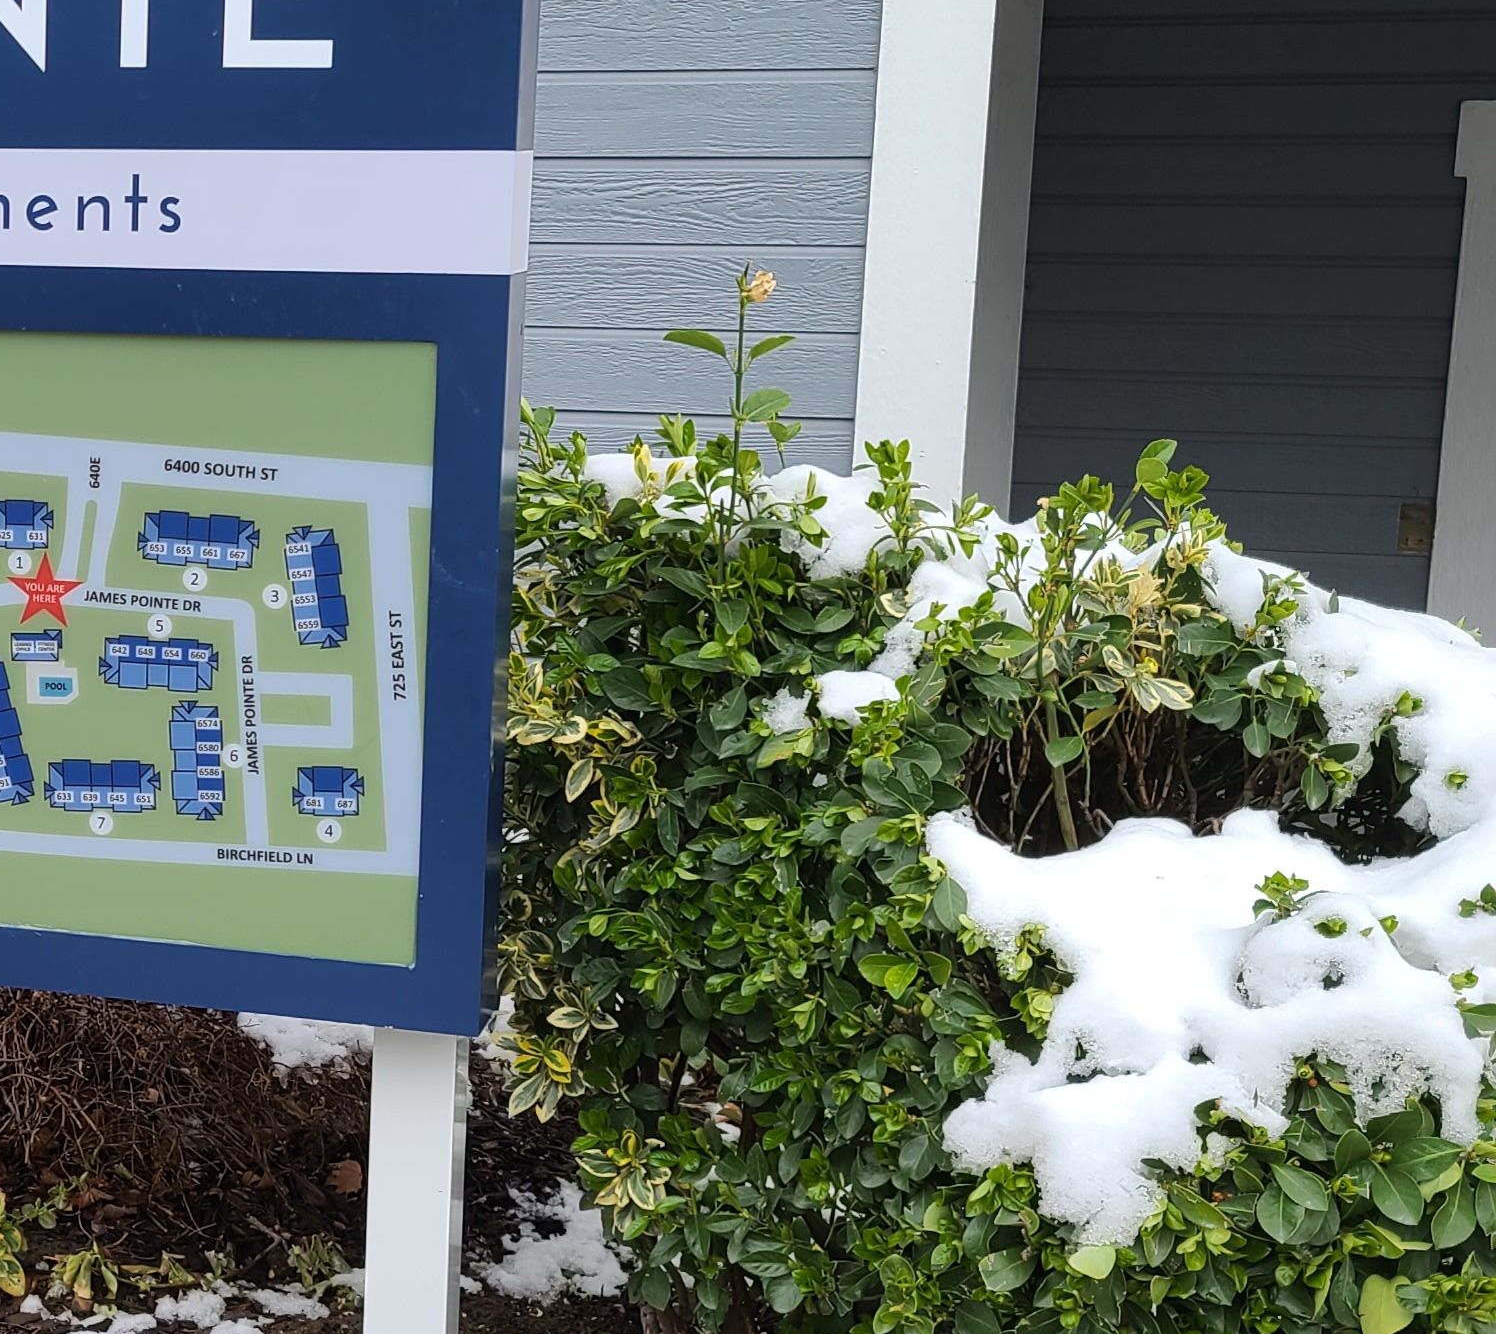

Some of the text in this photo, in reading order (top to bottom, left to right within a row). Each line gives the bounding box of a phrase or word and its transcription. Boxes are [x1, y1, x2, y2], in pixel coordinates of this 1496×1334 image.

[90, 457, 100, 488] 640E
[164, 459, 278, 481] 6400 SOUTH ST
[29, 533, 44, 541] 631
[149, 543, 245, 560] 653 655 661 667
[288, 545, 309, 554] 6541
[16, 557, 23, 568] 1
[190, 573, 199, 586] 2
[291, 570, 312, 579] 6547
[25, 583, 65, 594] YOU ARE
[33, 593, 57, 603] HERE
[270, 590, 279, 602] 3
[294, 595, 316, 604] 6553
[84, 591, 201, 613] JAMES POINTE DR
[156, 620, 164, 632] 5
[297, 620, 319, 629] 6559
[112, 646, 206, 660] 642 648 654 660
[389, 611, 406, 701] 725 EAST ST
[45, 682, 67, 690] POOL
[242, 655, 259, 774] JAMES POINTE DR
[198, 720, 218, 728] 6574
[198, 744, 219, 752] 6580
[230, 750, 238, 761] 6
[57, 793, 151, 804] 633 639 645 651
[200, 792, 220, 800] 6592
[306, 799, 353, 808] 681 687
[98, 817, 106, 828] 7
[324, 825, 333, 836] 4
[217, 849, 313, 864] BIRCHFIELD LN
